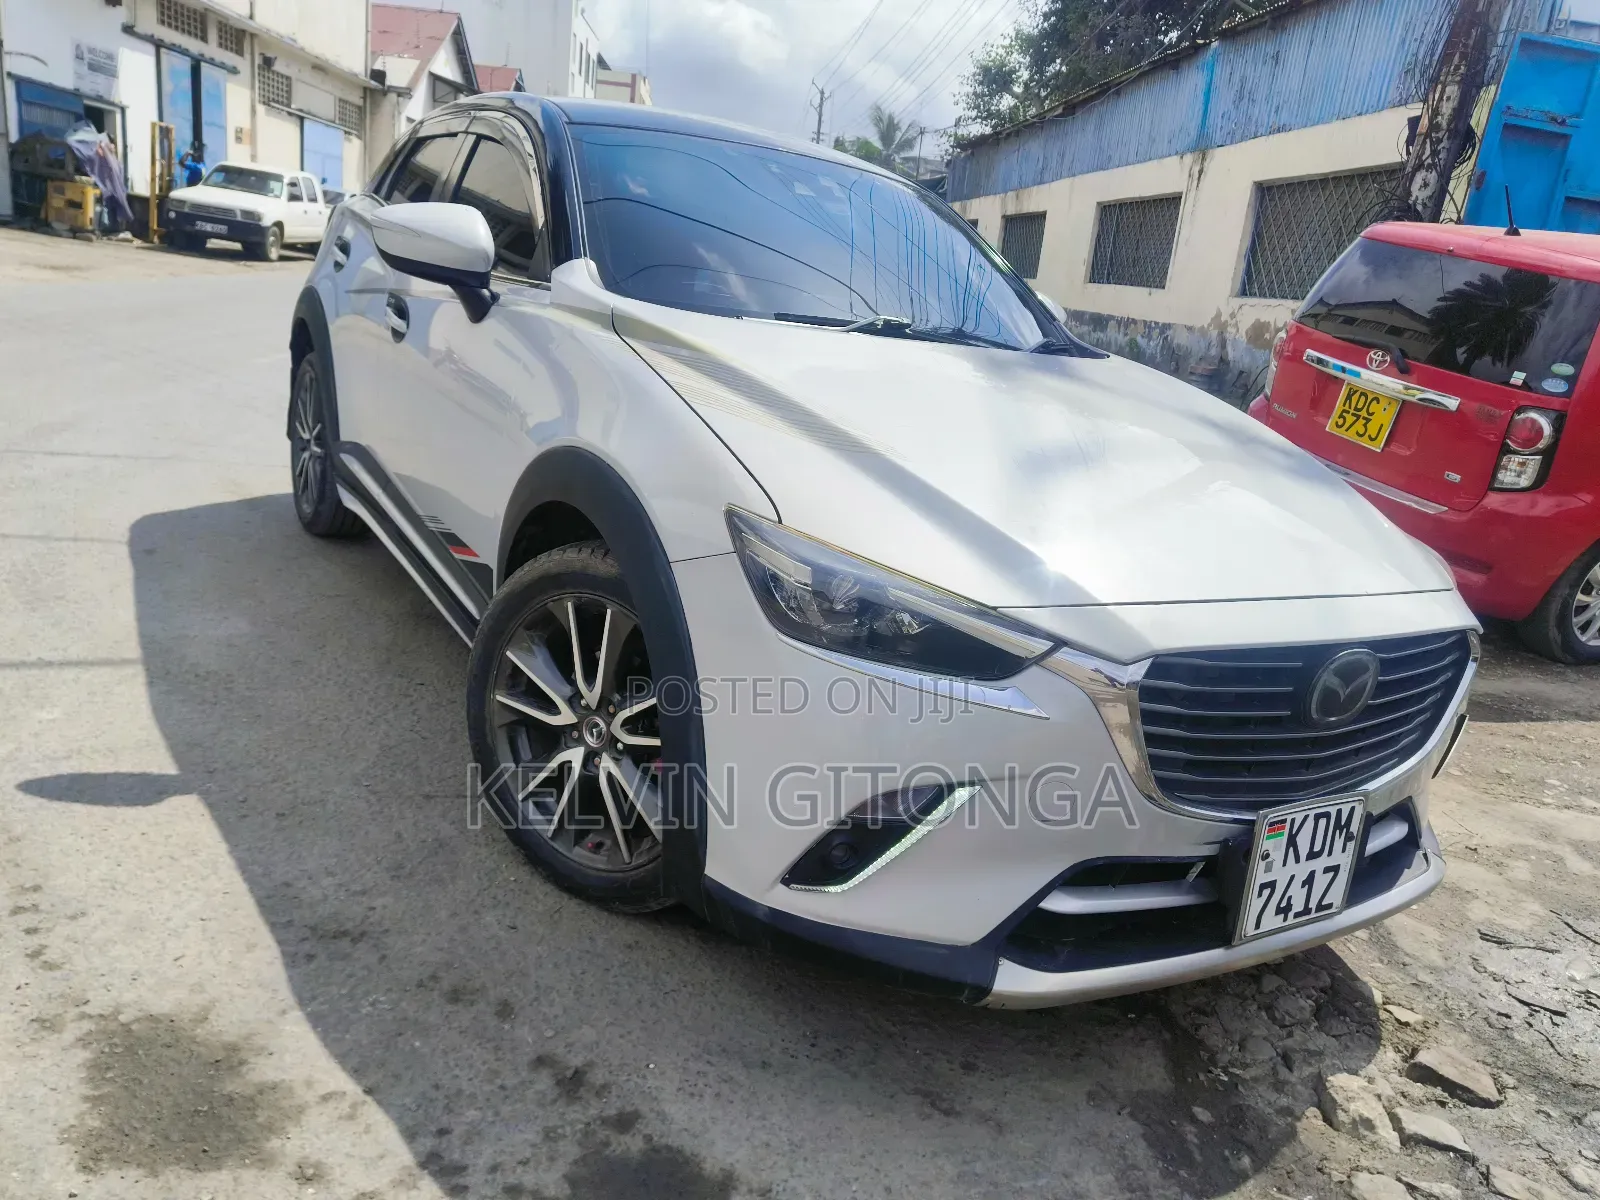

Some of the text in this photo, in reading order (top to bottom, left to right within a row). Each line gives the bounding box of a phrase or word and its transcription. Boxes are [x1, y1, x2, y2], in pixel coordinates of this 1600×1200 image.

[1335, 408, 1384, 442] 573J
[1342, 387, 1381, 417] KDC
[1282, 805, 1356, 867] KDM
[1254, 863, 1341, 931] 741Z
